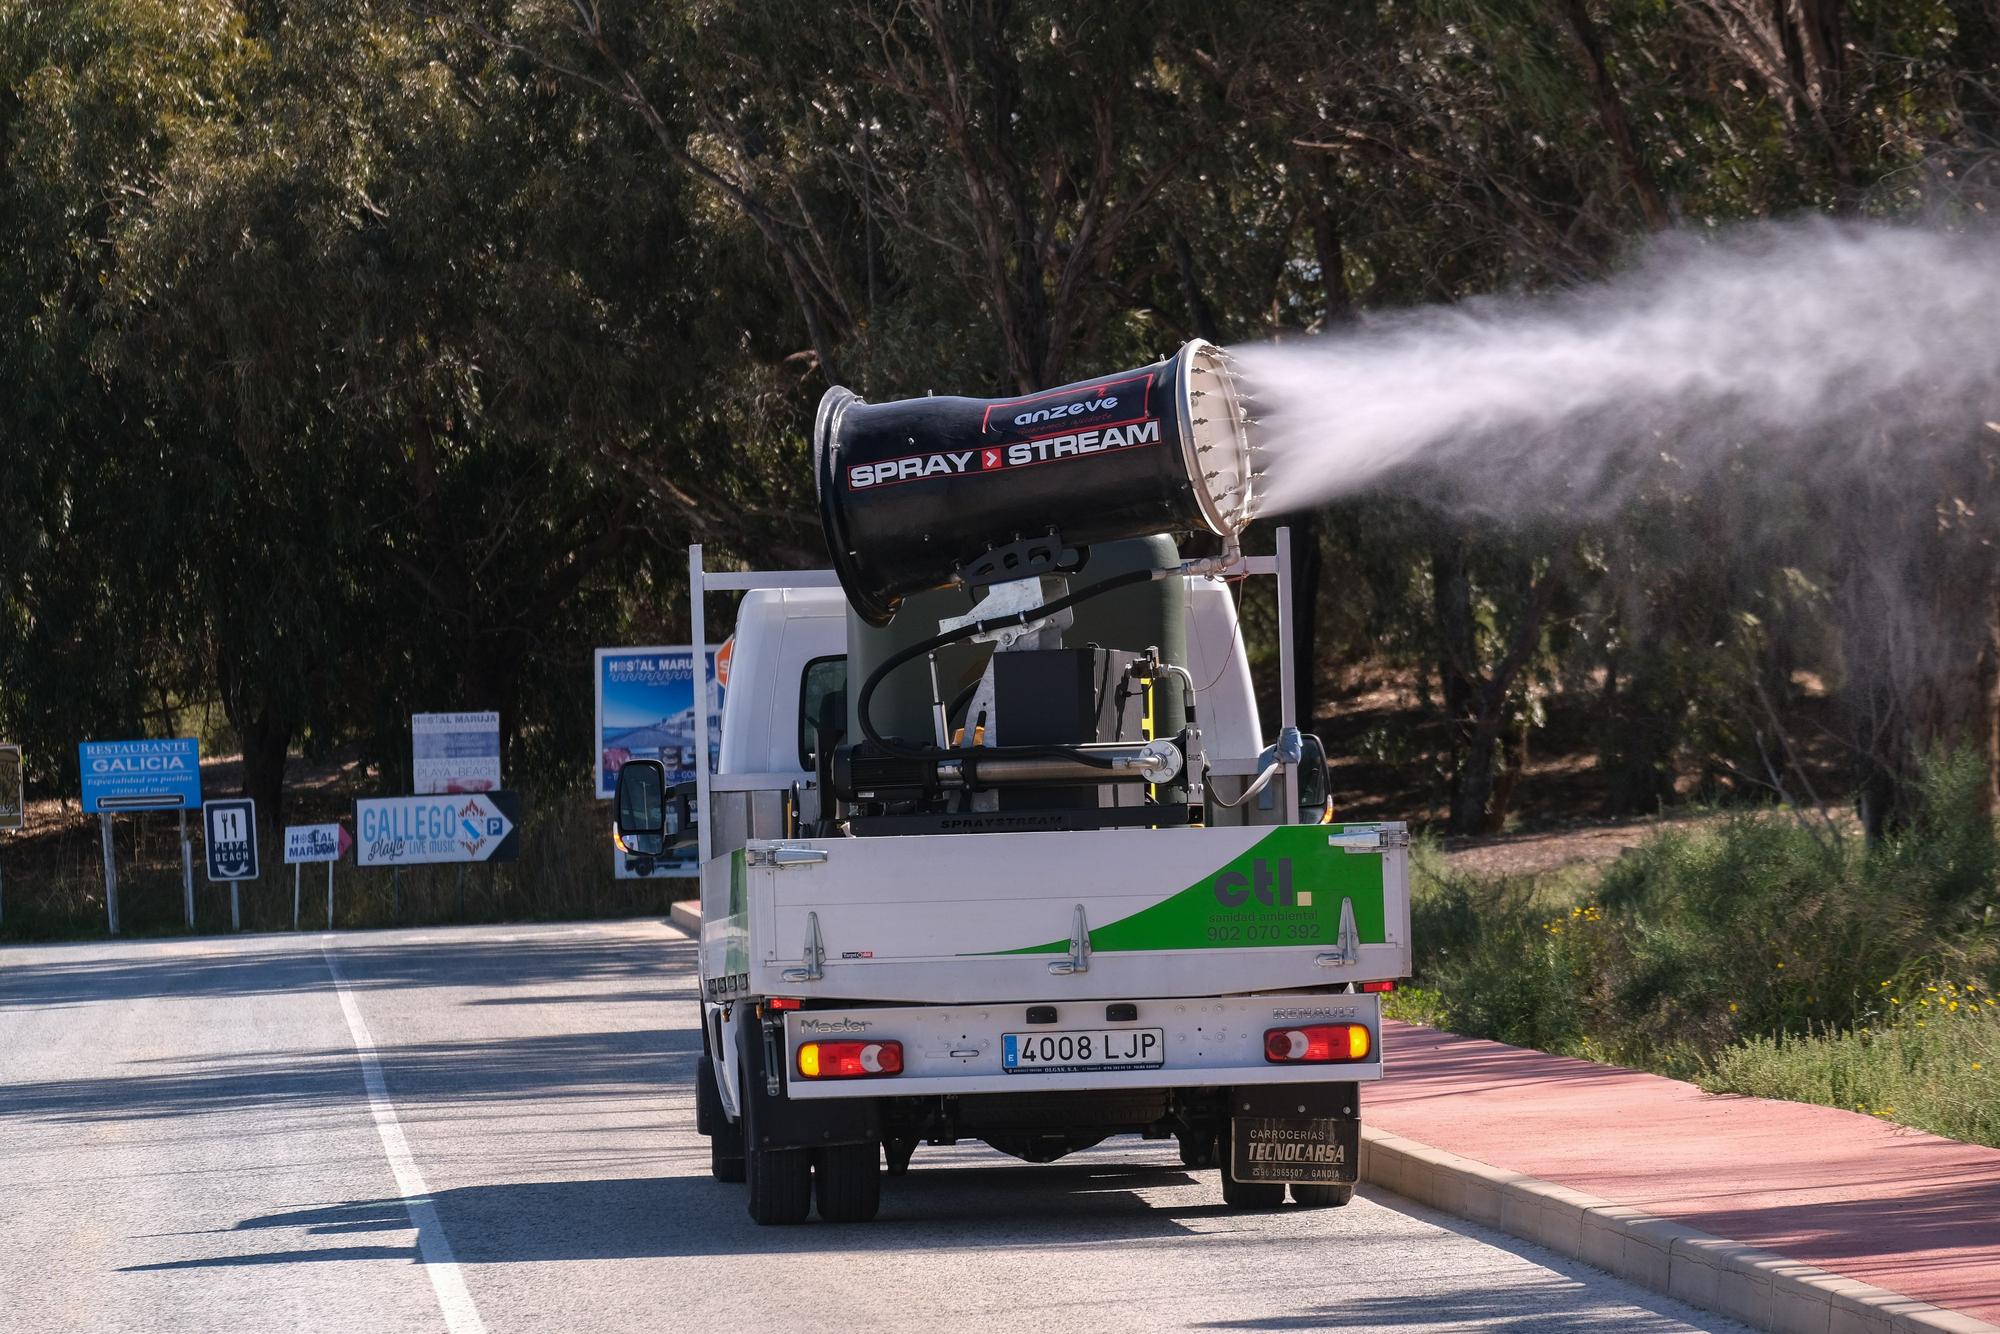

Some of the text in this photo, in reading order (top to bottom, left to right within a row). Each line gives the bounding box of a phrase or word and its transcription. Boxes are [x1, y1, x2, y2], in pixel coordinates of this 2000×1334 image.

[1014, 397, 1118, 425] anzeve
[850, 451, 974, 488] SPRAY
[1008, 420, 1159, 465] STREAM
[455, 714, 497, 723] MARUJA
[87, 742, 191, 755] RESTAURANTE
[92, 756, 184, 772] GALICIA
[417, 766, 497, 777] PLAYA BEACH
[363, 804, 456, 842] GALLEGO
[941, 815, 1063, 829] SPRAYSTREAM
[214, 841, 248, 851] PLAYA
[367, 836, 456, 861] Playa LIVE MUSIC
[215, 852, 249, 862] BEACH
[1208, 908, 1318, 923] sanidad ambiental
[1207, 923, 1321, 941] 902 070 392
[1273, 1006, 1359, 1019] RENAULT
[801, 1017, 873, 1034] Master
[1022, 1033, 1156, 1061] 4008 LJP
[1250, 1129, 1325, 1140] CARROCERIAS
[1248, 1142, 1345, 1162] TECNOCARSA
[1311, 1169, 1340, 1178] GANDIA
